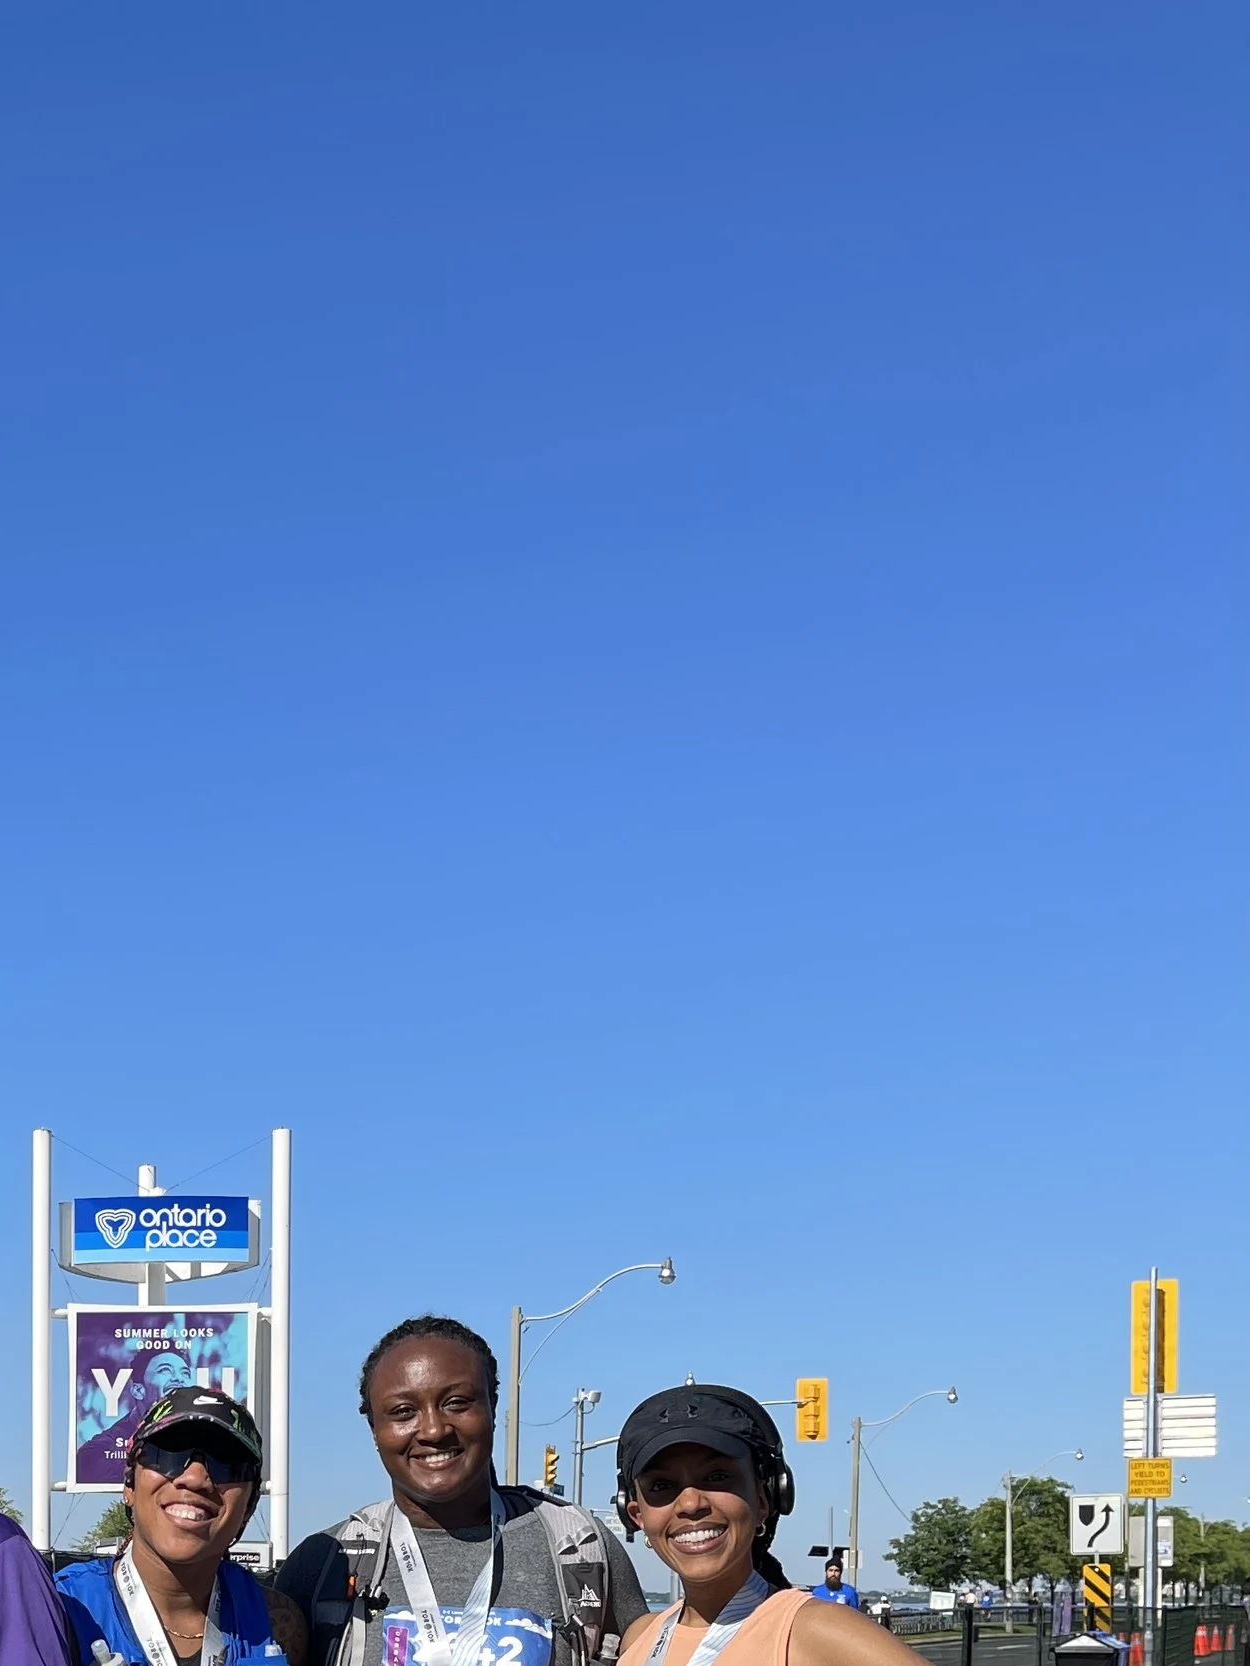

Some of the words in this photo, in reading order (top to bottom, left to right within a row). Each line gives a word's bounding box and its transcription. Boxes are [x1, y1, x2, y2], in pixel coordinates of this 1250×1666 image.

[139, 1203, 226, 1227] ontario
[146, 1221, 217, 1252] place
[114, 1328, 167, 1338] SUMMER
[174, 1327, 214, 1338] LOOKS
[136, 1340, 170, 1350] GOOD
[175, 1339, 192, 1350] ON
[1131, 1462, 1145, 1470] LEFT
[1148, 1462, 1170, 1470] TURNS
